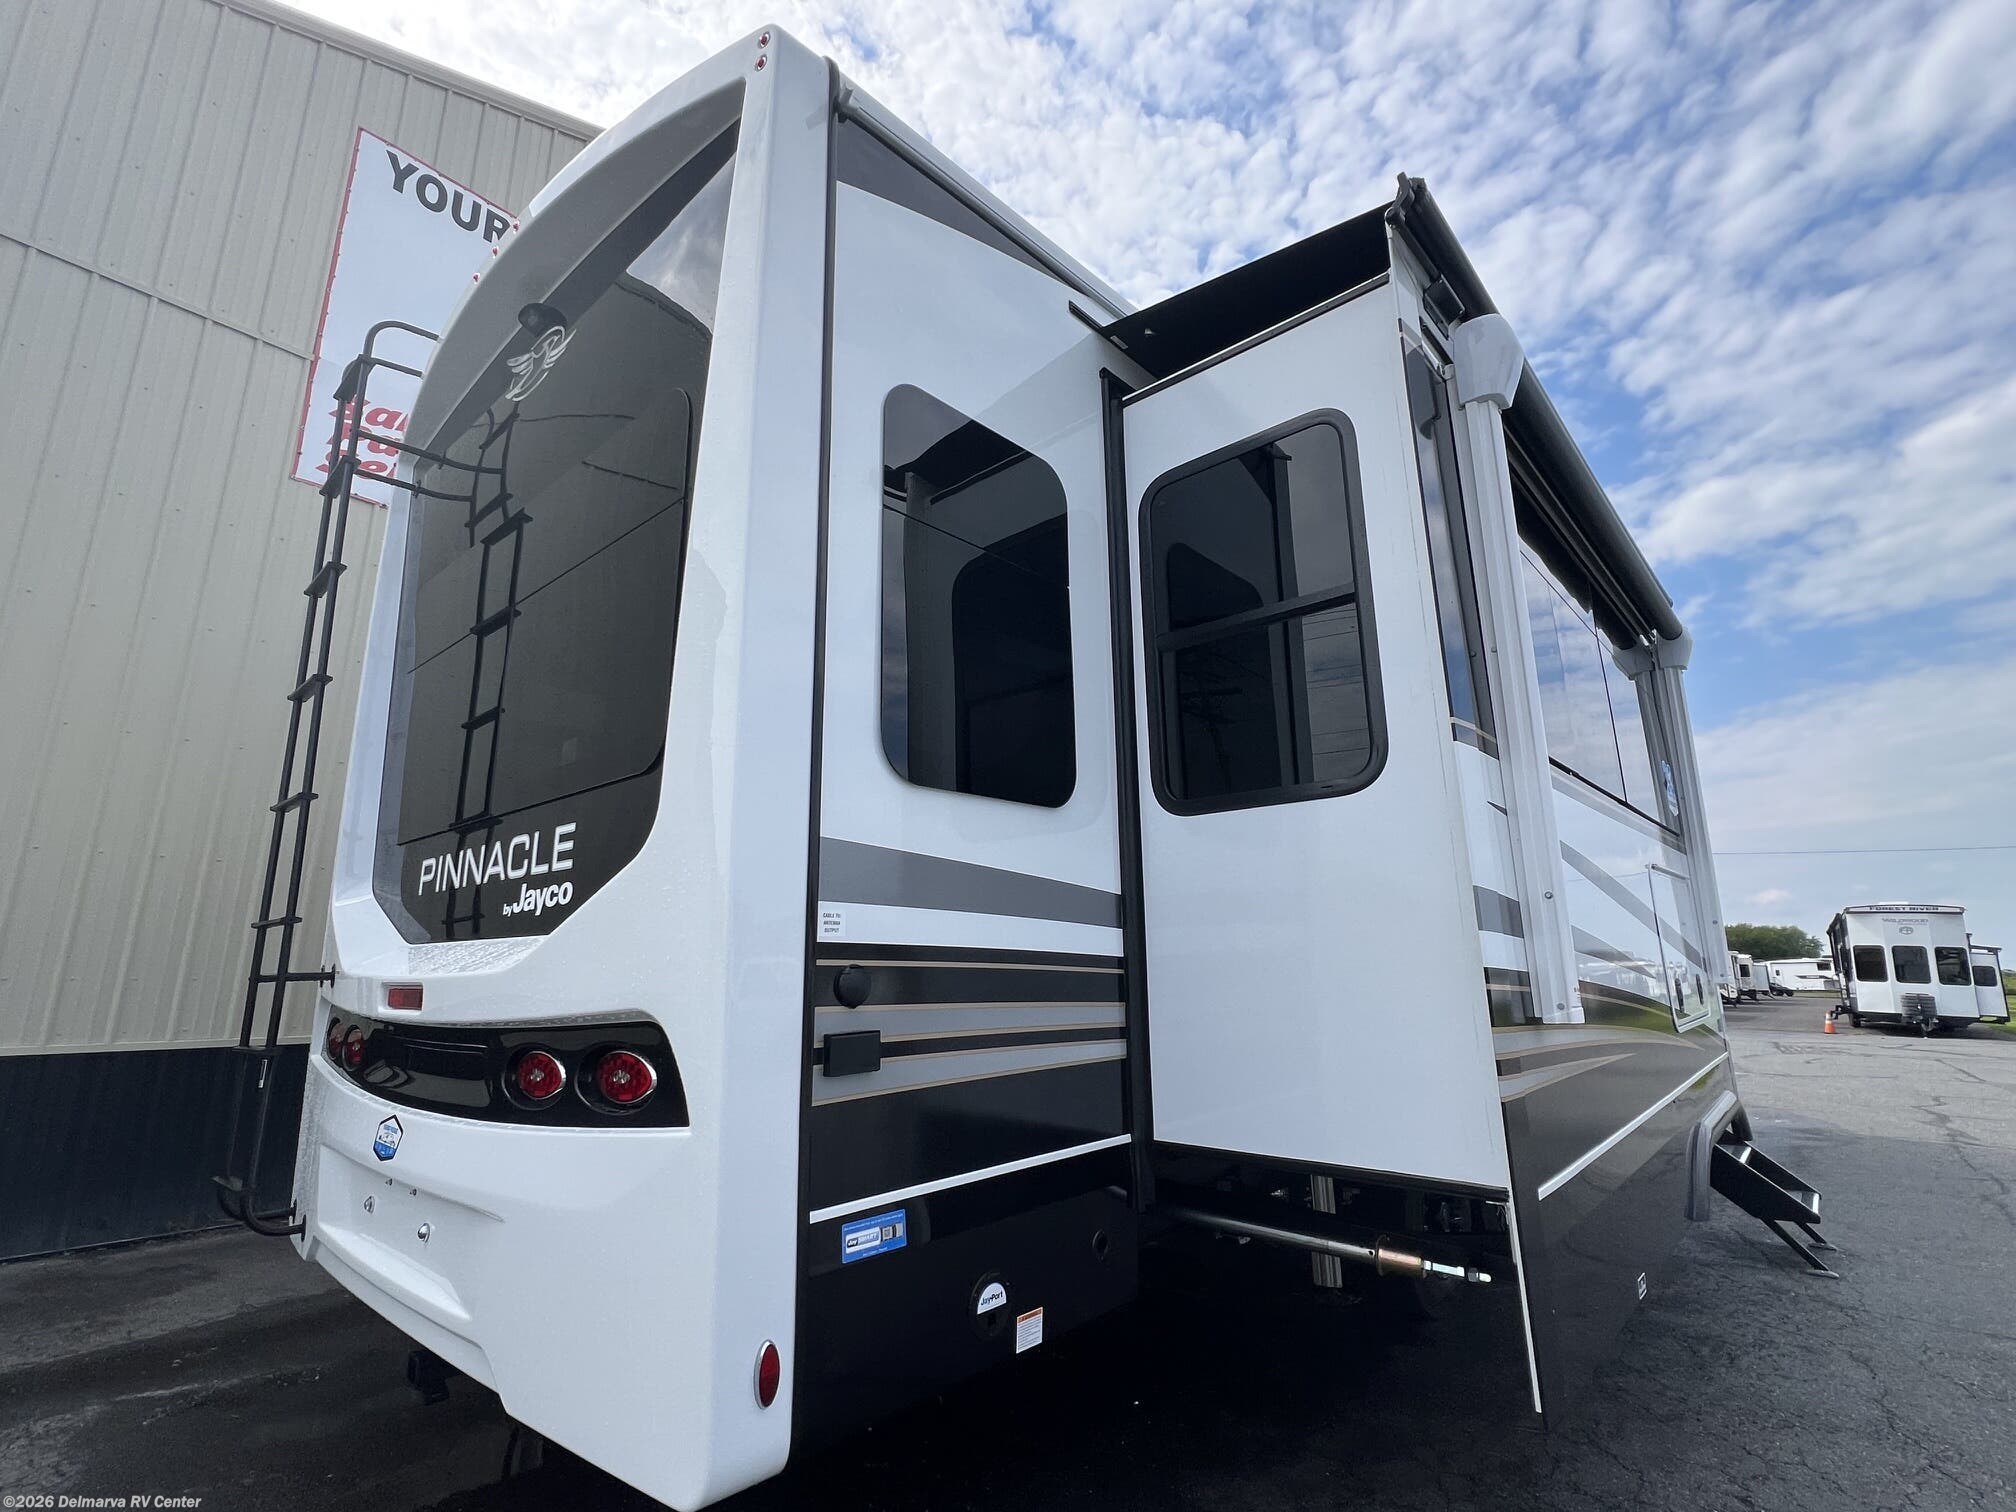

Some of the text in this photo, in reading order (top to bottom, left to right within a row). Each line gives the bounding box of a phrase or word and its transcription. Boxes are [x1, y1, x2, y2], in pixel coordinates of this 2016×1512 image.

[386, 149, 511, 243] YOUR
[418, 822, 577, 896] PINNACLE
[503, 881, 574, 917] by Jayco
